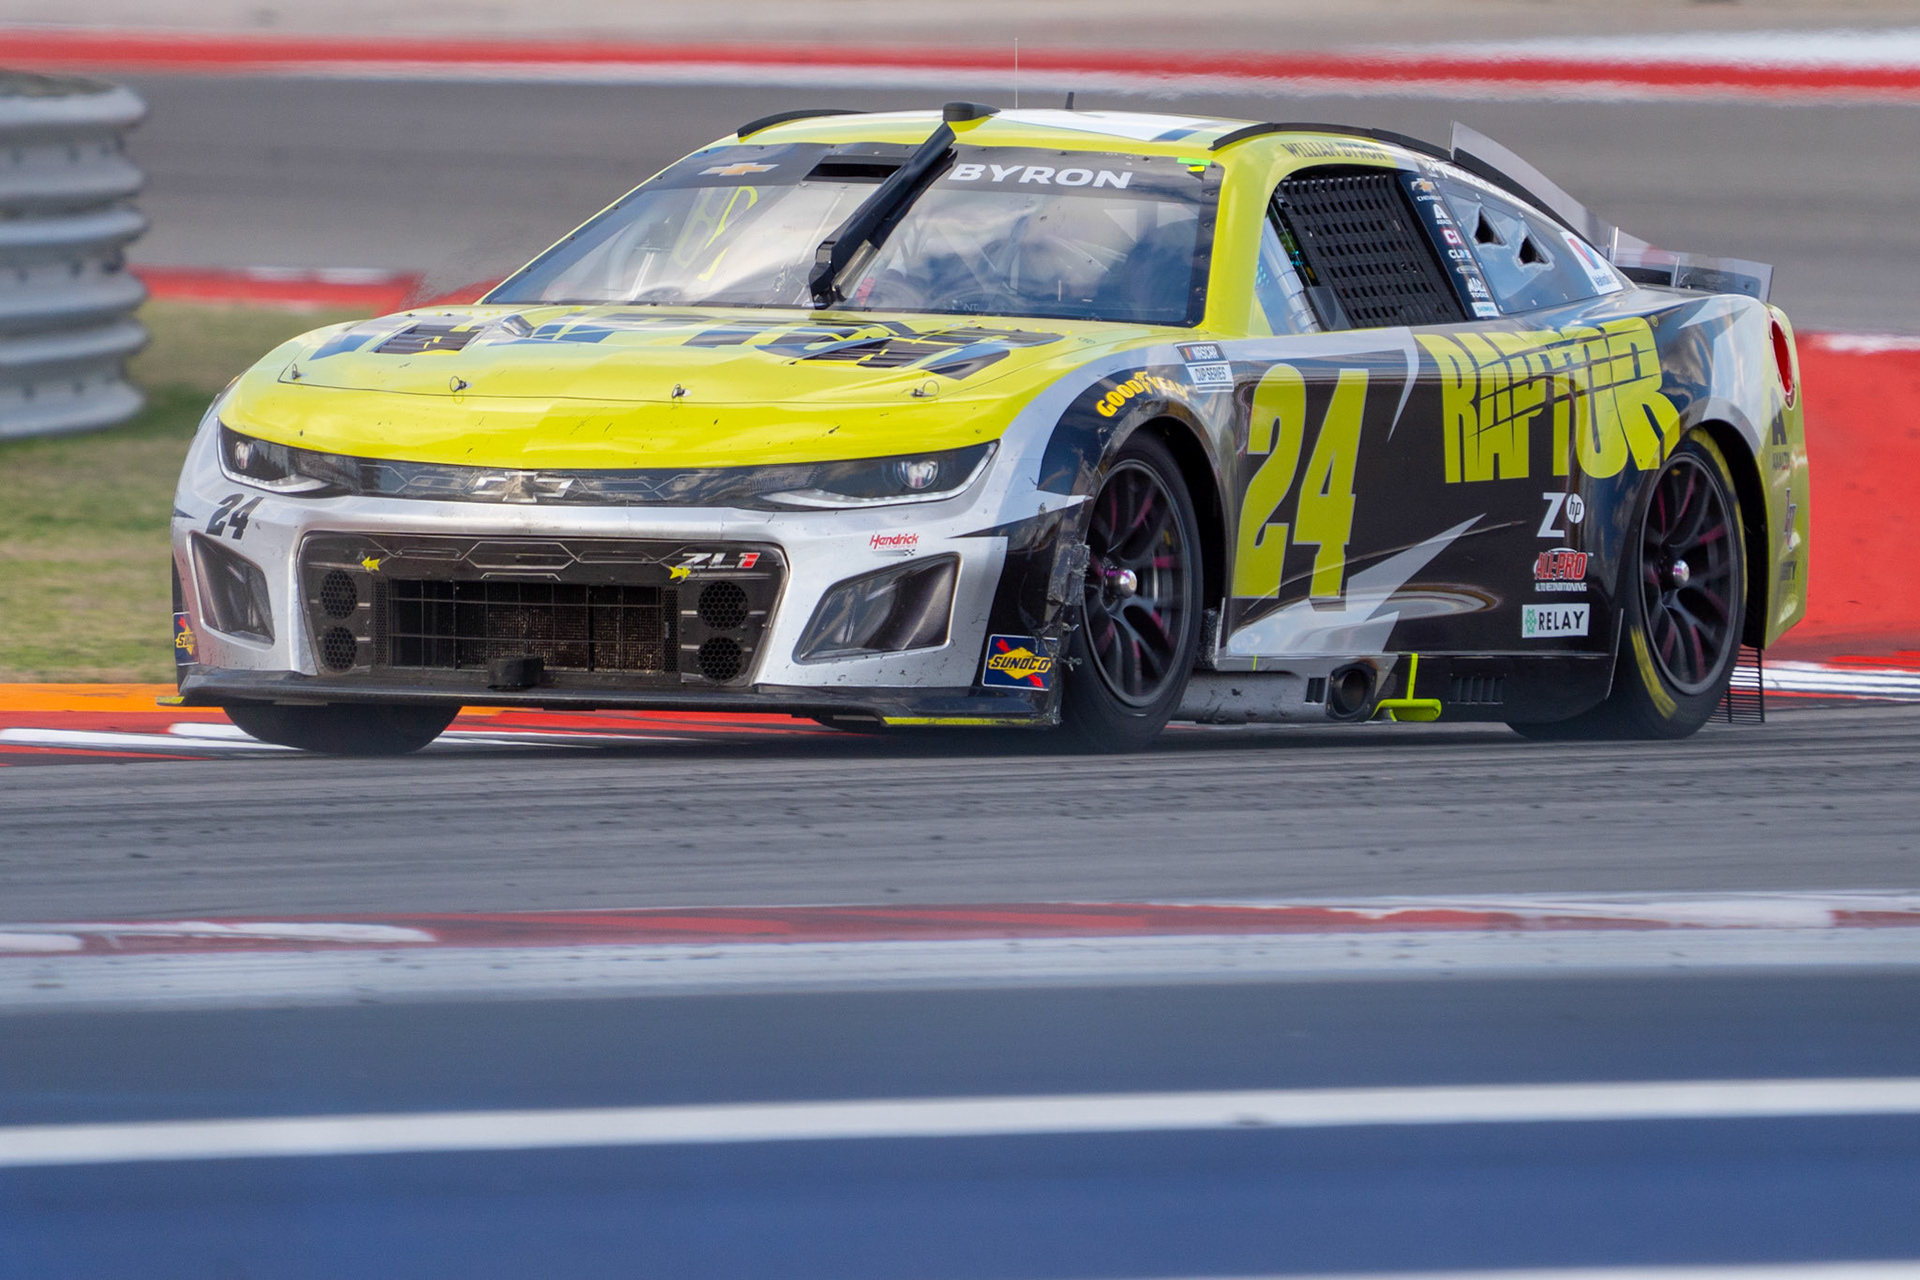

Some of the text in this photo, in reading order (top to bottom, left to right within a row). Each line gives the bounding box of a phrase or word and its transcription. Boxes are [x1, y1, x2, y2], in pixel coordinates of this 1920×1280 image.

[1281, 142, 1341, 159] WILLIAM
[948, 163, 1133, 189] BYRON
[1192, 345, 1220, 360] NASCAR
[1194, 366, 1227, 382] CUP SERIES
[1096, 371, 1190, 418] GOODYEAR
[1413, 316, 1680, 483] RAPTOR
[1231, 363, 1369, 598] 24
[205, 493, 265, 540] 24
[1536, 492, 1582, 537] Z hp
[869, 533, 919, 550] Hendrick
[674, 552, 761, 569] ZL1
[1534, 551, 1587, 580] ALL-PRO
[1538, 611, 1584, 631] RELAY
[991, 656, 1051, 671] SUNOCO
